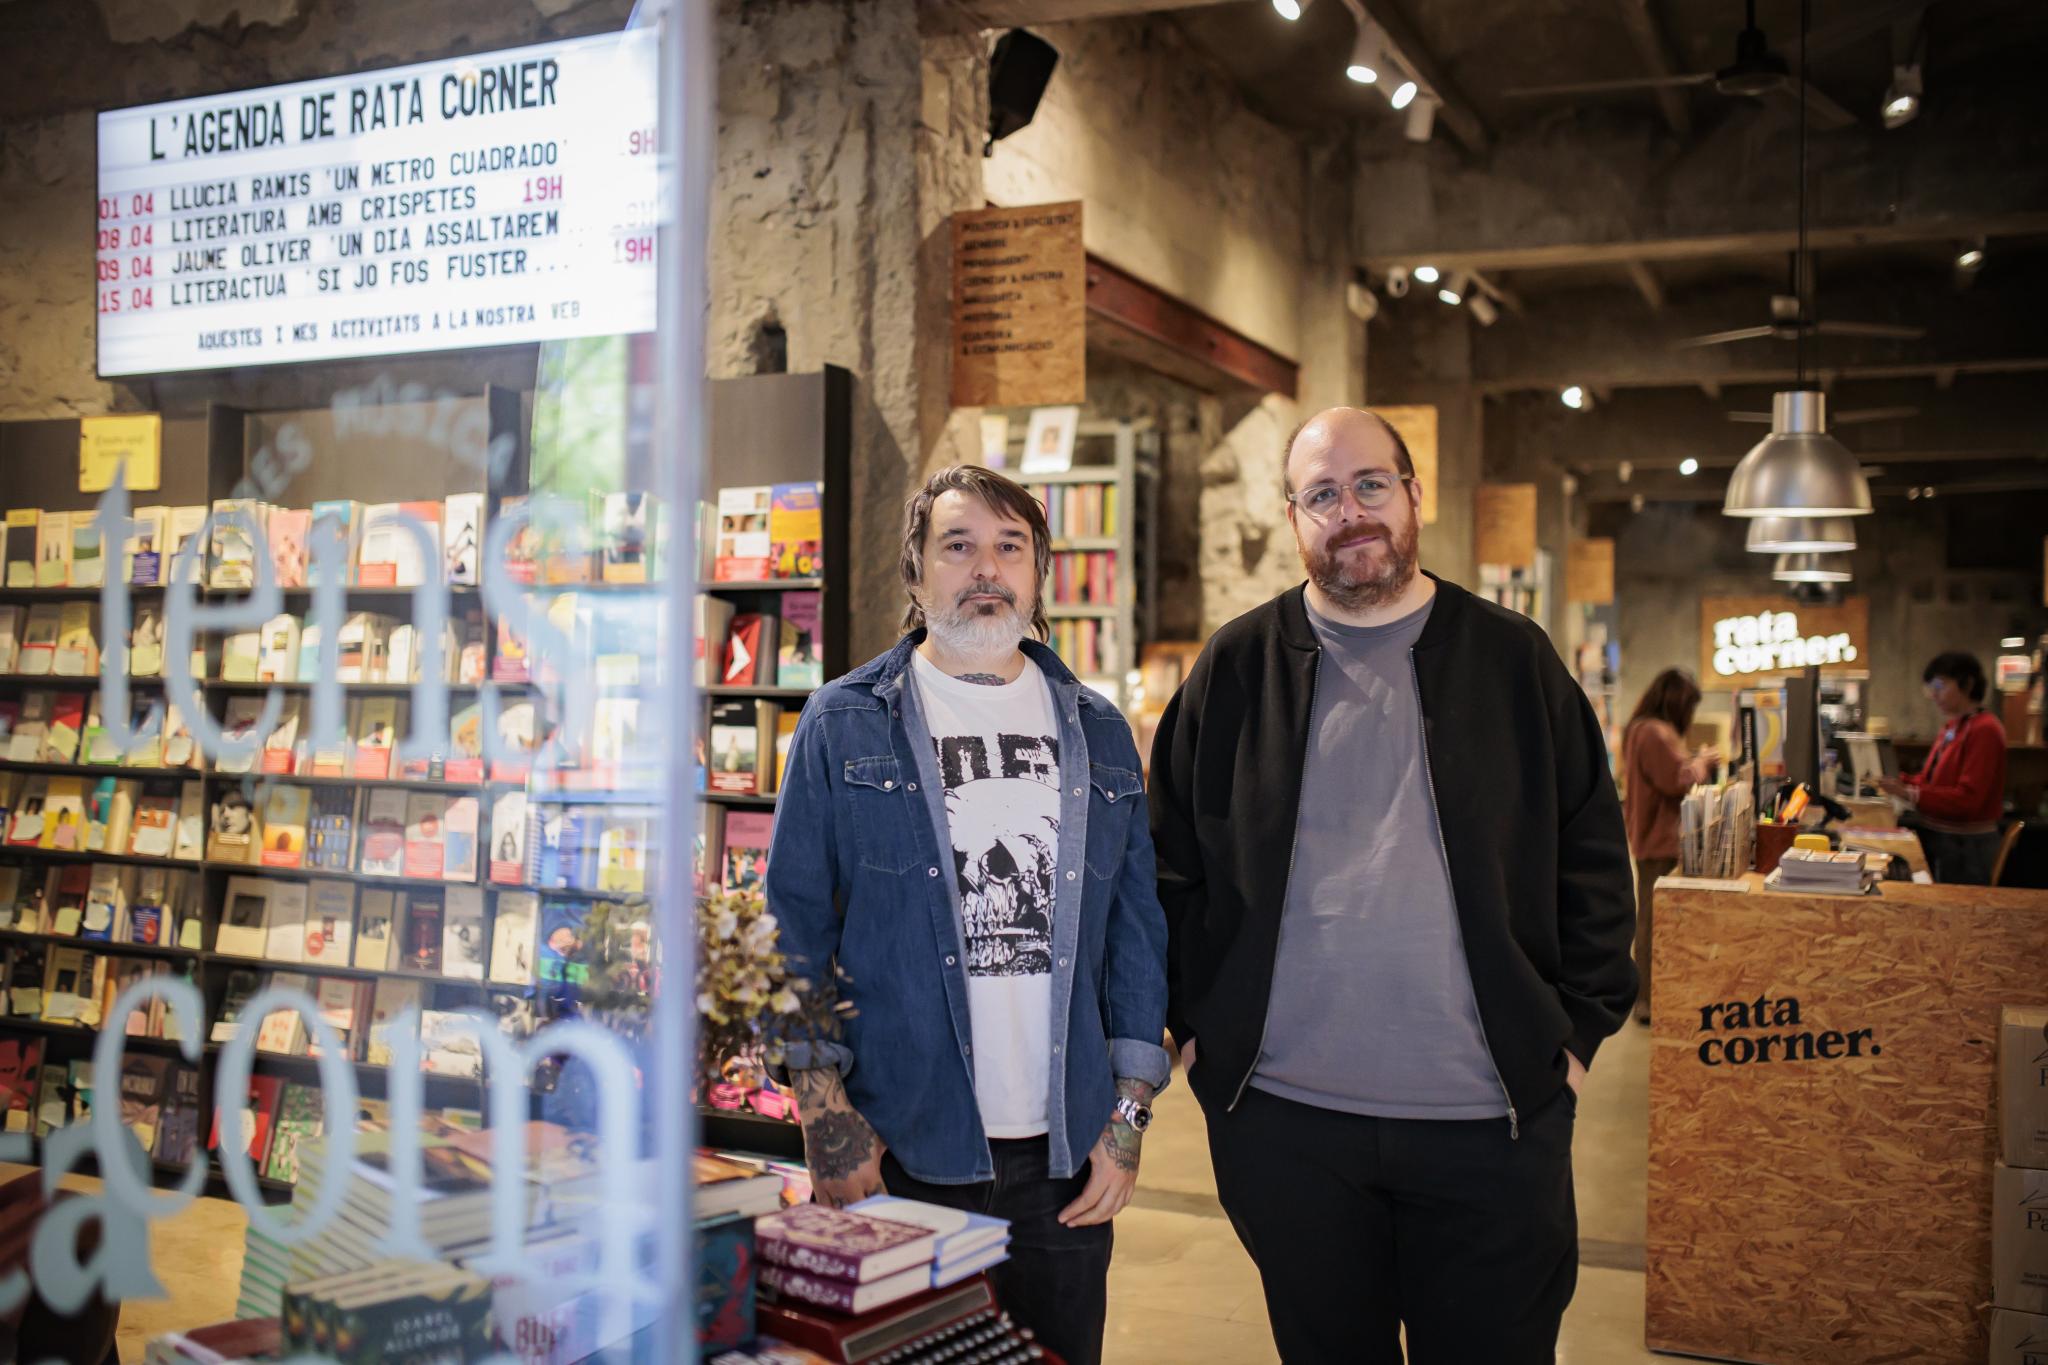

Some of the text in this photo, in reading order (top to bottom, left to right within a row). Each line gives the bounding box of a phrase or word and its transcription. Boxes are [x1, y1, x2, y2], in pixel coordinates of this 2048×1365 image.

[151, 60, 559, 160] L'AGENDA DE RATA CORNER
[171, 181, 237, 211] LLUCIA
[252, 173, 310, 201] RAMIS
[371, 157, 434, 186] METRO
[171, 210, 287, 242] LITERATURA
[307, 203, 342, 227] AMB
[361, 186, 476, 222] CRISPETES
[523, 175, 563, 203] 19H
[172, 248, 227, 274] JAUME
[241, 239, 312, 267] OLIVER
[374, 227, 411, 254] DIA
[171, 273, 287, 306] LITERACTUA
[354, 265, 377, 288] JO
[391, 260, 429, 285] FOS
[198, 328, 263, 350] AQUESTES
[276, 325, 283, 343] I
[331, 313, 420, 339] ACTIVITATS
[432, 311, 441, 329] A
[450, 309, 468, 330] LA
[1713, 610, 1798, 649] rata
[1712, 632, 1857, 676] corner.
[1697, 993, 1801, 1032] rata
[1698, 1027, 1882, 1067] corner.
